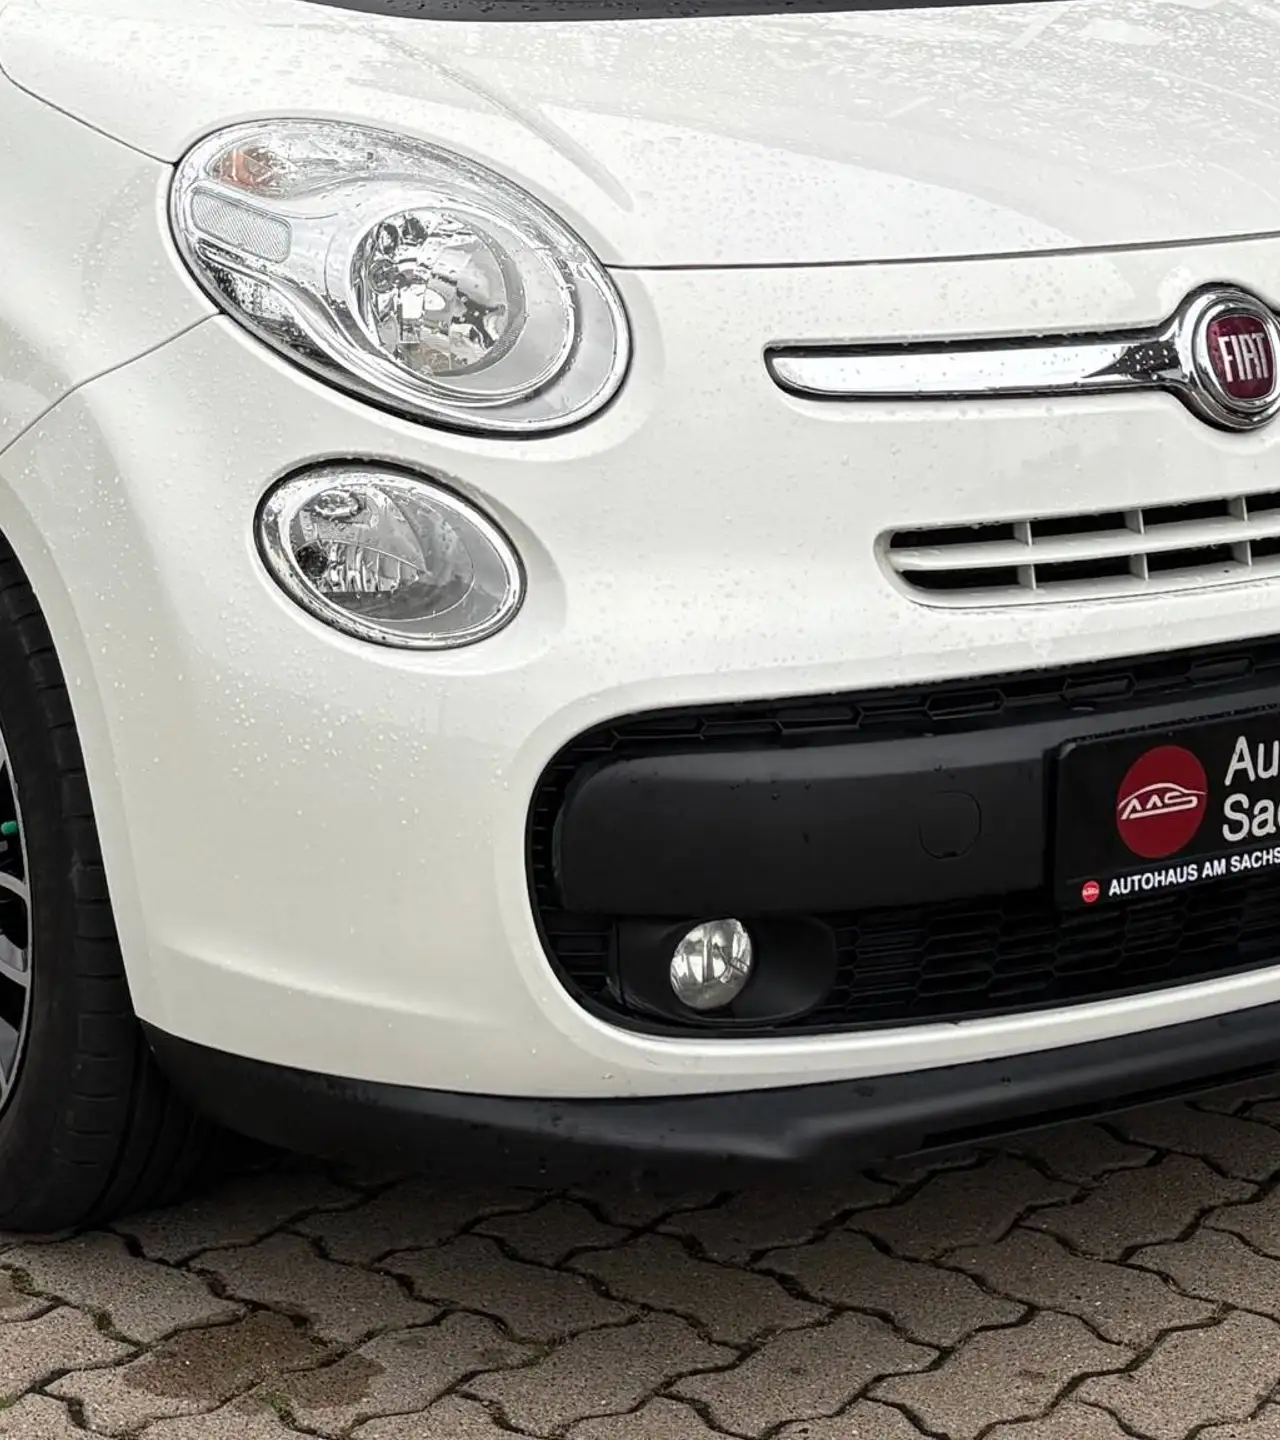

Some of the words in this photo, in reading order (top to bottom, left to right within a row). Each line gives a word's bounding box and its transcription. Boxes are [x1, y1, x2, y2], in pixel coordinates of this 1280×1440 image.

[1218, 332, 1269, 383] FIAT
[1108, 863, 1199, 897] AUTOHAUS
[1202, 858, 1227, 879] AM
